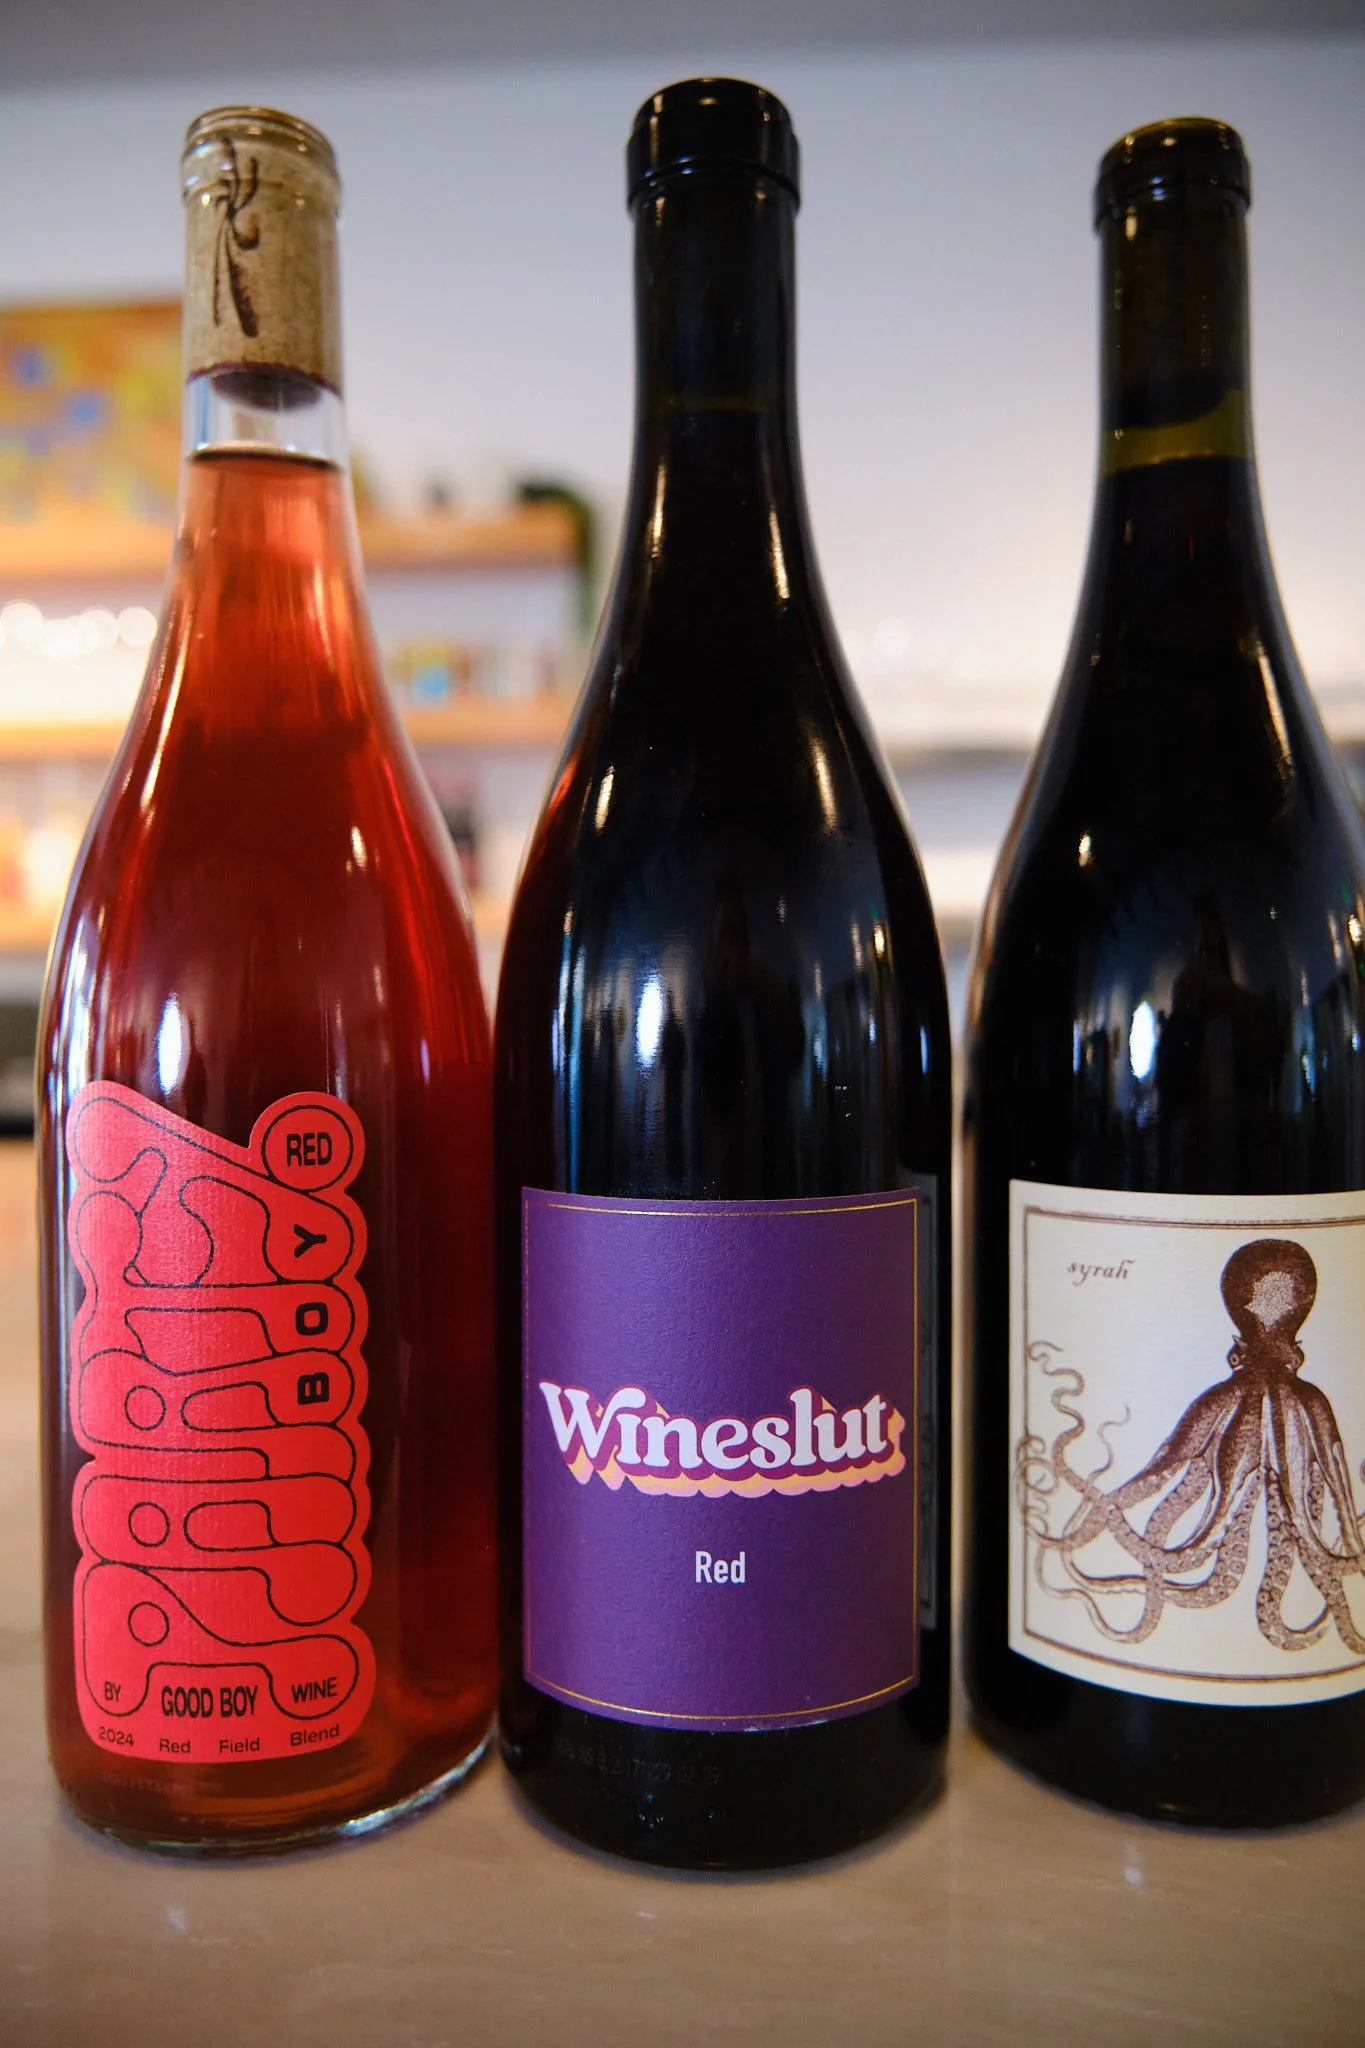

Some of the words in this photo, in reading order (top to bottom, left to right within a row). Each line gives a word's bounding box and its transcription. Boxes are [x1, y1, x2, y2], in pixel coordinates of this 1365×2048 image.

[286, 1132, 333, 1167] RED
[1067, 1259, 1136, 1287] syrah
[293, 1223, 330, 1406] BOY
[539, 1381, 895, 1482] Wineslut
[695, 1550, 746, 1583] Red
[104, 1681, 122, 1703] BY
[161, 1685, 214, 1718] GOOD
[219, 1685, 259, 1718] BOY
[291, 1676, 339, 1704] WINE
[98, 1726, 135, 1747] 2024
[159, 1738, 191, 1753] Red
[219, 1737, 261, 1754] Field
[289, 1724, 340, 1747] Blend
